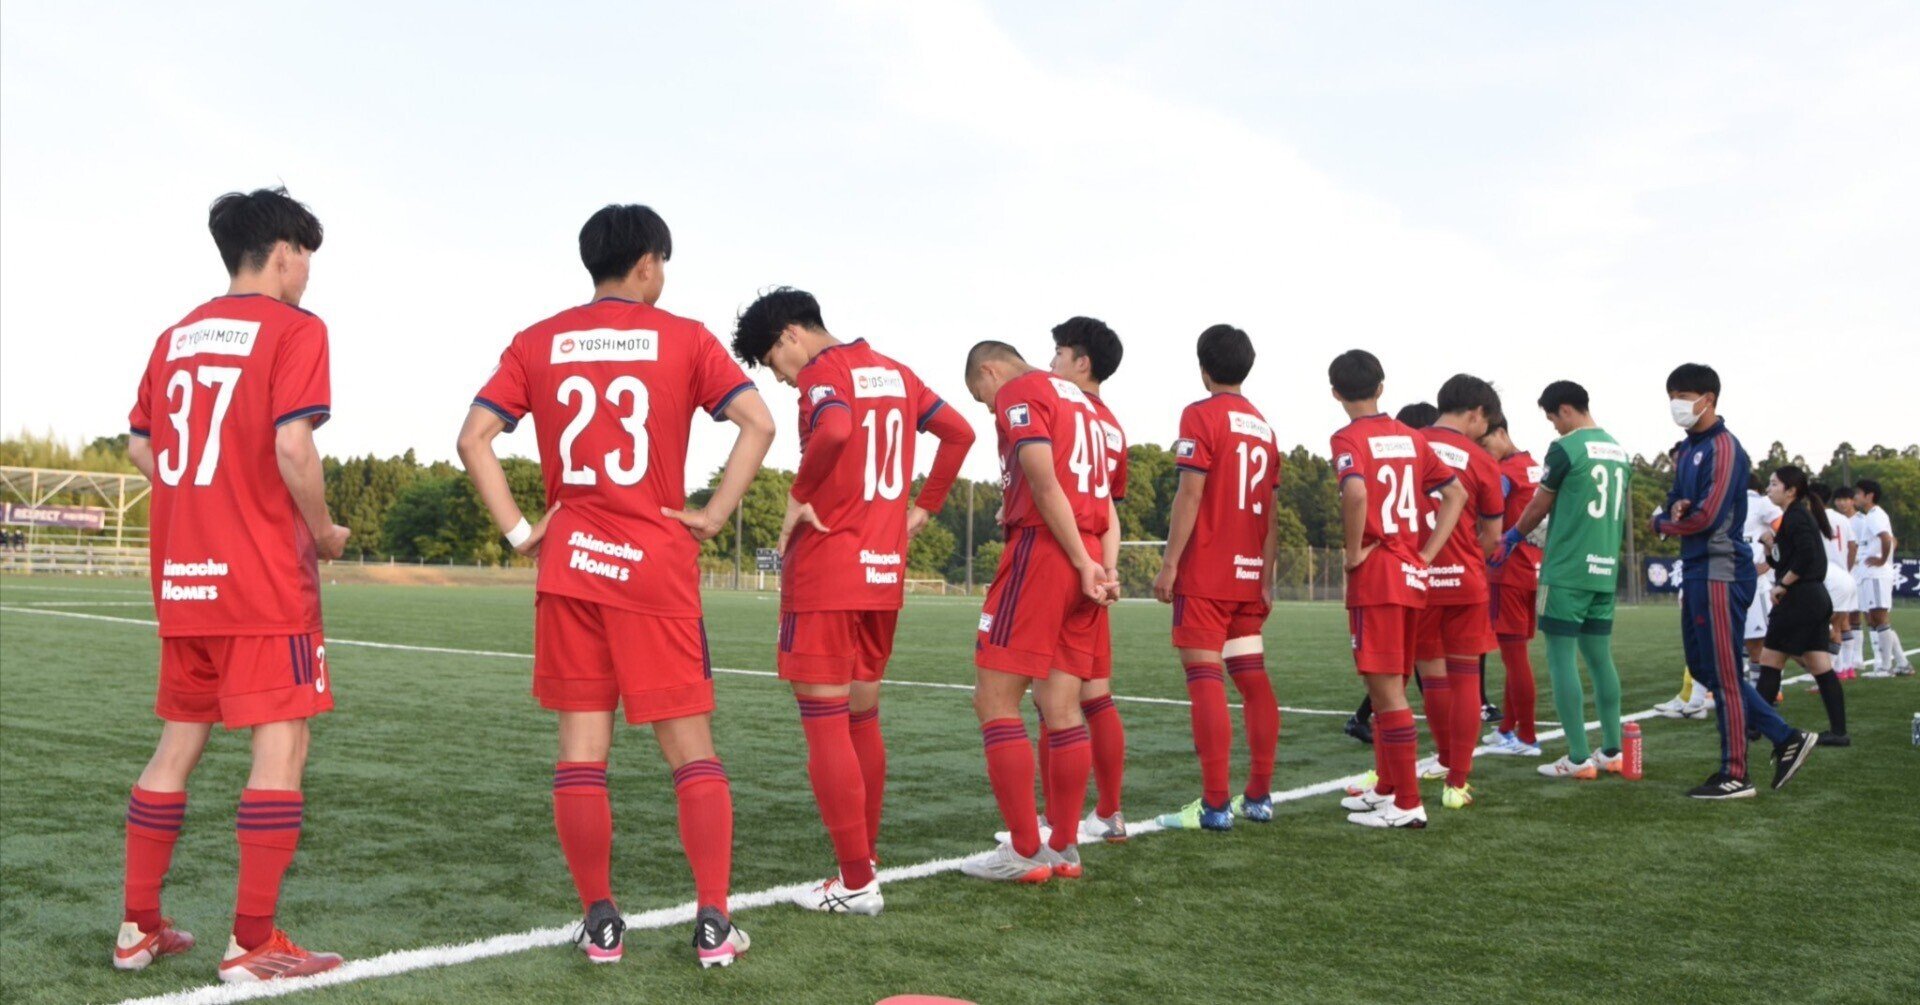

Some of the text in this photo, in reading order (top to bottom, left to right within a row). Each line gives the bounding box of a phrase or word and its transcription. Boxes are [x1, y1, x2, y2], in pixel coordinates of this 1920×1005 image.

[579, 338, 650, 351] YOSHIMOTO
[158, 365, 242, 487] 37
[557, 375, 649, 486] 23
[862, 408, 904, 501] 10
[1069, 411, 1109, 498] 40
[1236, 441, 1268, 515] 12
[1377, 464, 1418, 534] 24
[1587, 464, 1625, 522] 31
[163, 558, 229, 577] imachu
[567, 531, 644, 562] Shimachu
